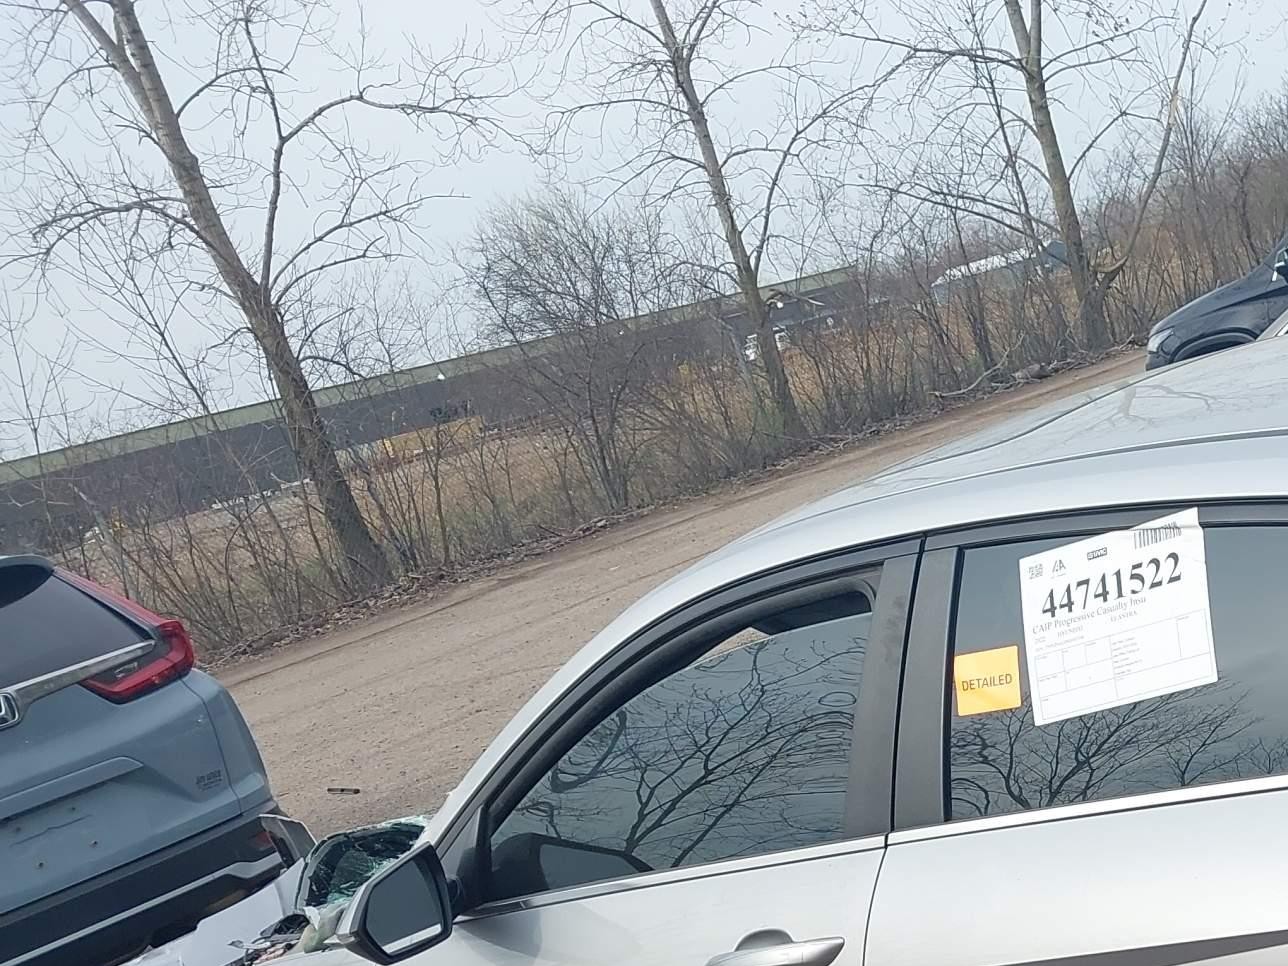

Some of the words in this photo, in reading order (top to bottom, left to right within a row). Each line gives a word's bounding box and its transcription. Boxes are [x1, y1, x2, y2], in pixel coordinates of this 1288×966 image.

[1042, 551, 1182, 618] 44741522
[1054, 609, 1095, 628] Progressive
[1096, 600, 1127, 615] Casualty
[962, 672, 1013, 692] DETAILED
